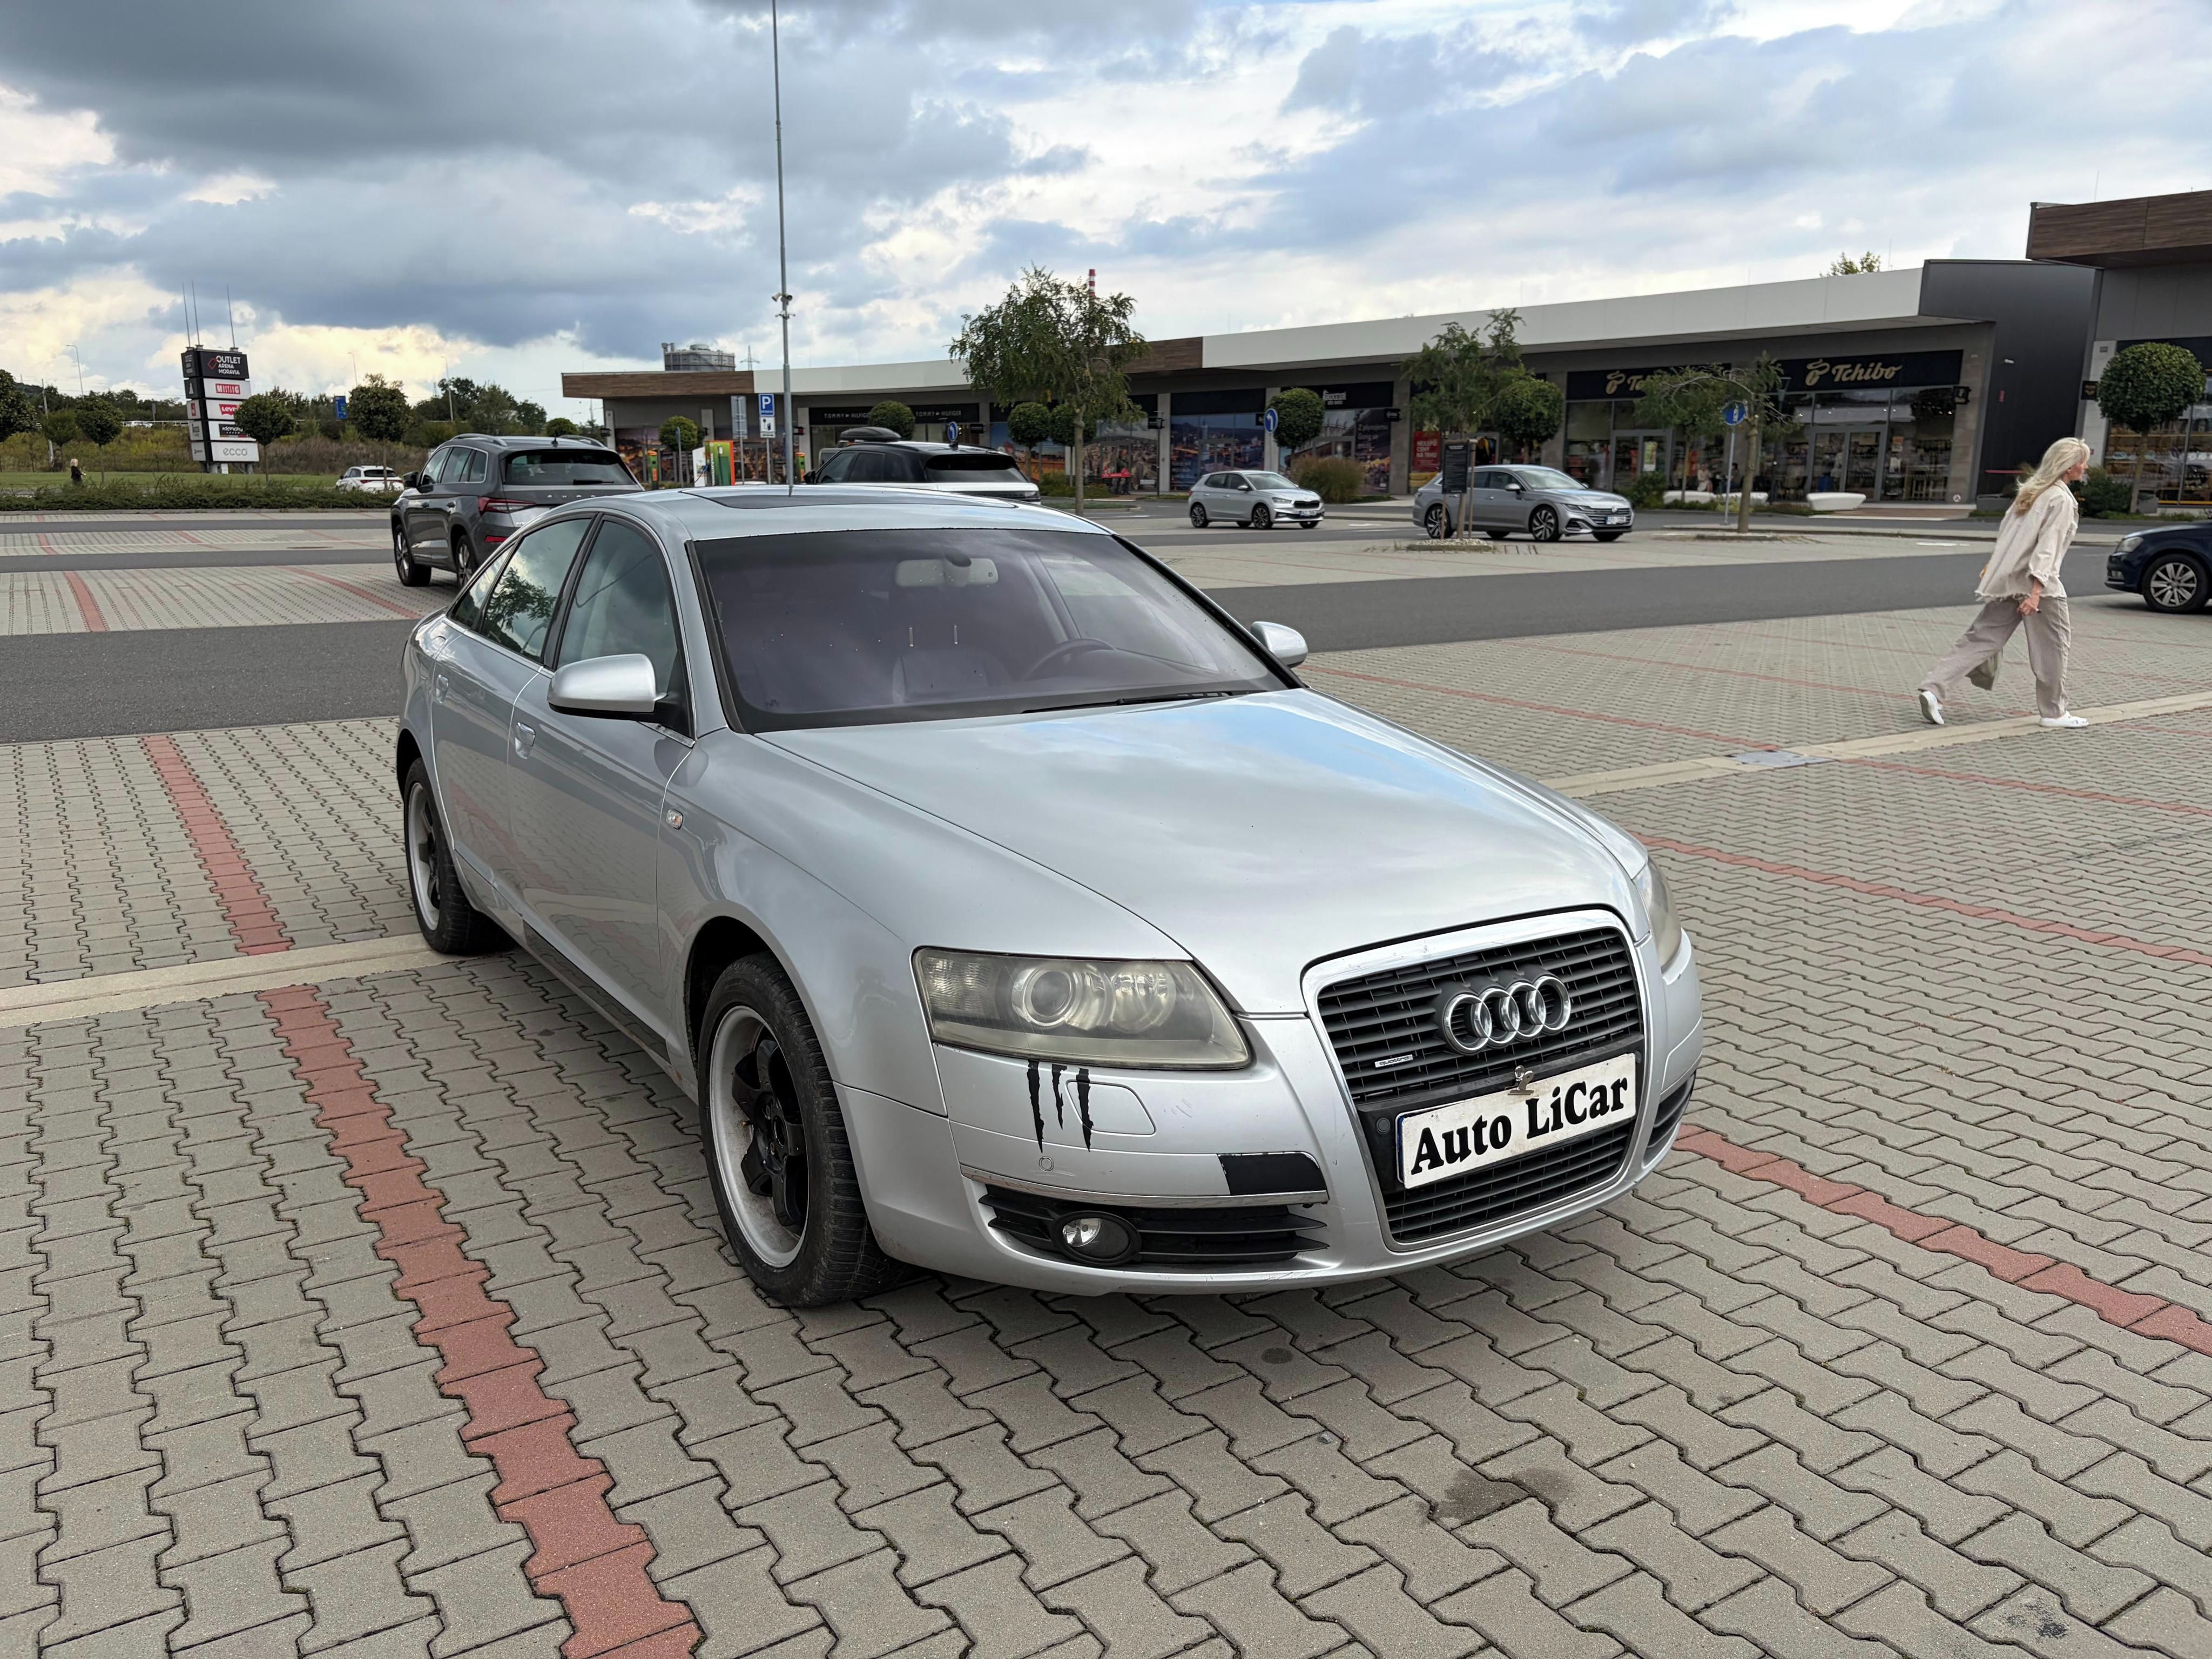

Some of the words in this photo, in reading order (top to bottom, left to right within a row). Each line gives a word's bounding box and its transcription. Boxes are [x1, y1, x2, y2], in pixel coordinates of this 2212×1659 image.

[216, 355, 241, 364] OUTLET
[1831, 361, 1903, 382] Tchibo
[762, 396, 771, 409] P
[222, 448, 247, 456] ecco
[1379, 1056, 1409, 1065] quattro
[1411, 1115, 1512, 1175] Auto
[1526, 1077, 1628, 1139] LiCar
